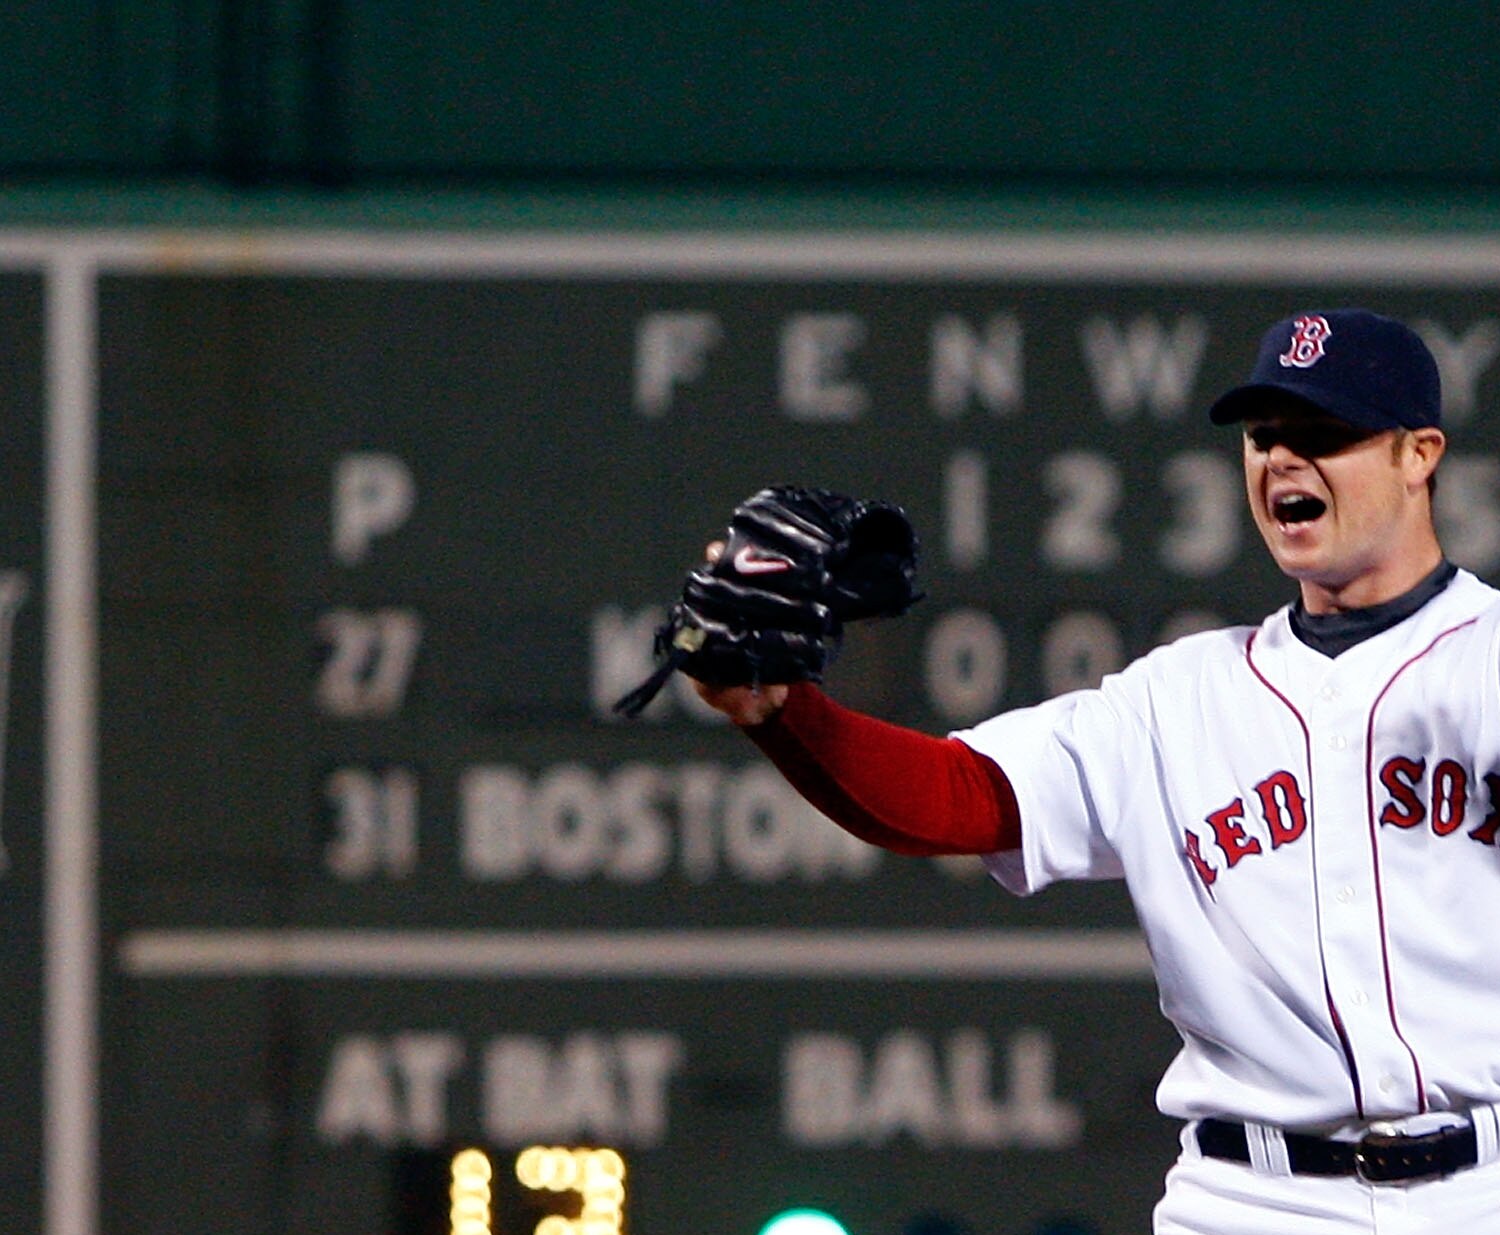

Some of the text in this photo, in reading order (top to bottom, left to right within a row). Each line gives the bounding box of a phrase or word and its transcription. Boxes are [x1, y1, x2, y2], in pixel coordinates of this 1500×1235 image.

[1279, 315, 1332, 368] B
[334, 455, 410, 563] P
[946, 455, 984, 567] 1
[1044, 455, 1120, 569] 2
[1166, 457, 1239, 571] 3
[929, 612, 1001, 717] 0
[322, 1037, 458, 1137] AT
[486, 1037, 680, 1139] BAT
[784, 1035, 1078, 1141] BALL
